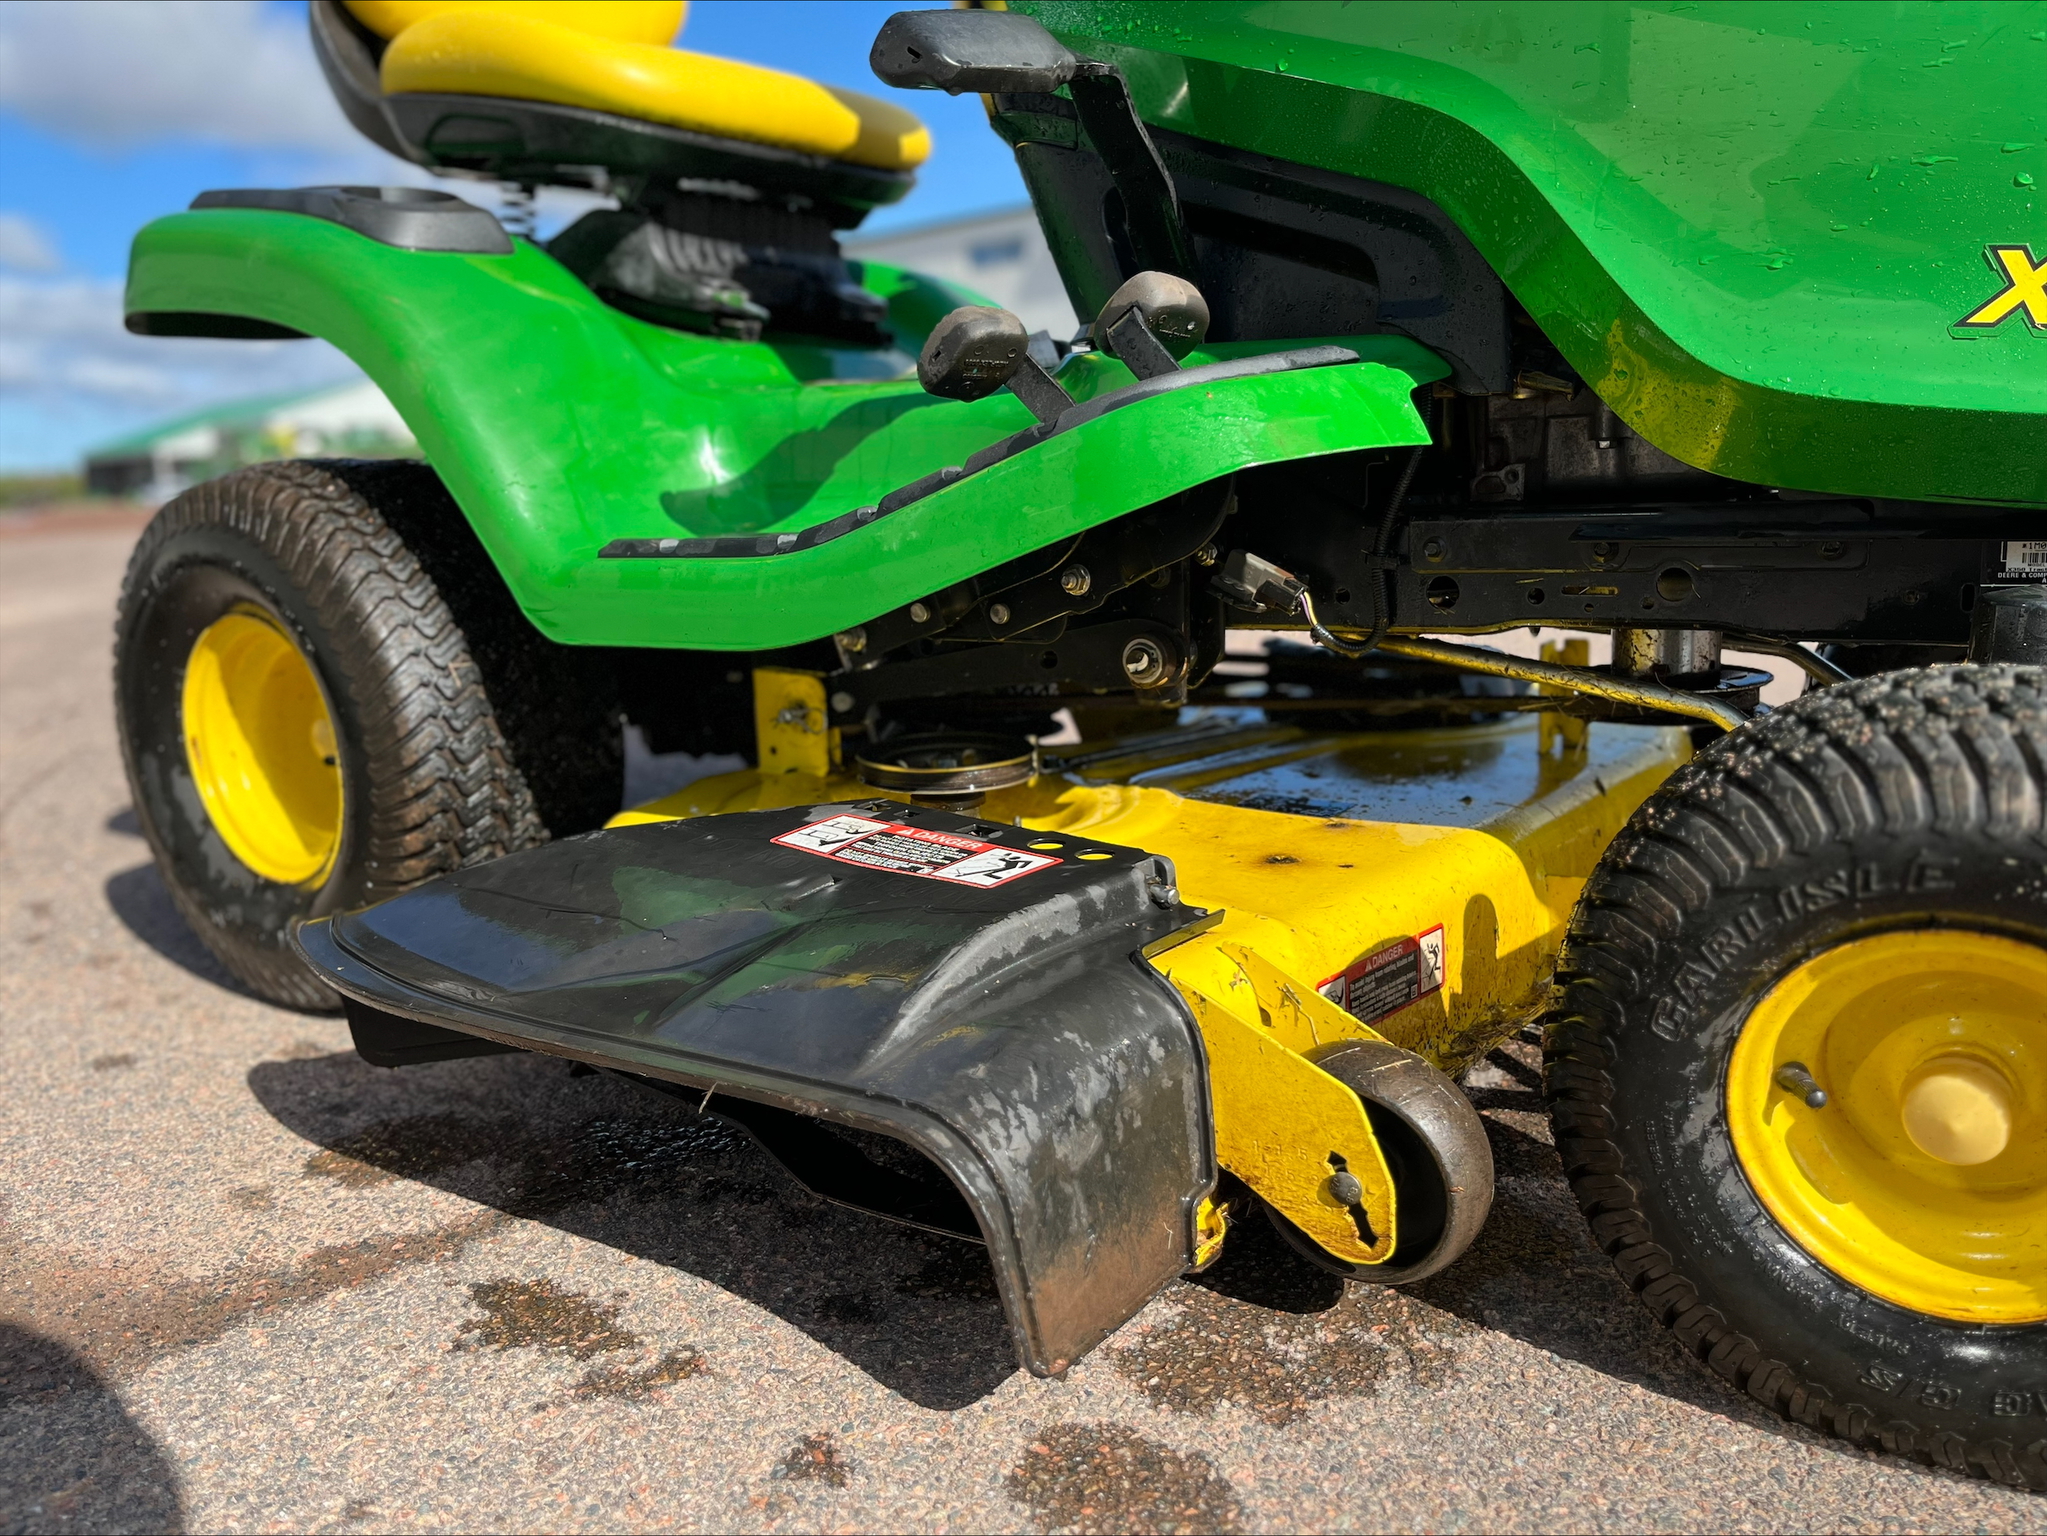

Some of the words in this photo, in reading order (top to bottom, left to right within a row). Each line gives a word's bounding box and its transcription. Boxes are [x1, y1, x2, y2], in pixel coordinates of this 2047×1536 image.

[915, 830, 983, 850] DANGER
[1372, 944, 1404, 967] DANGER
[1651, 848, 1961, 1042] CARLISLE
